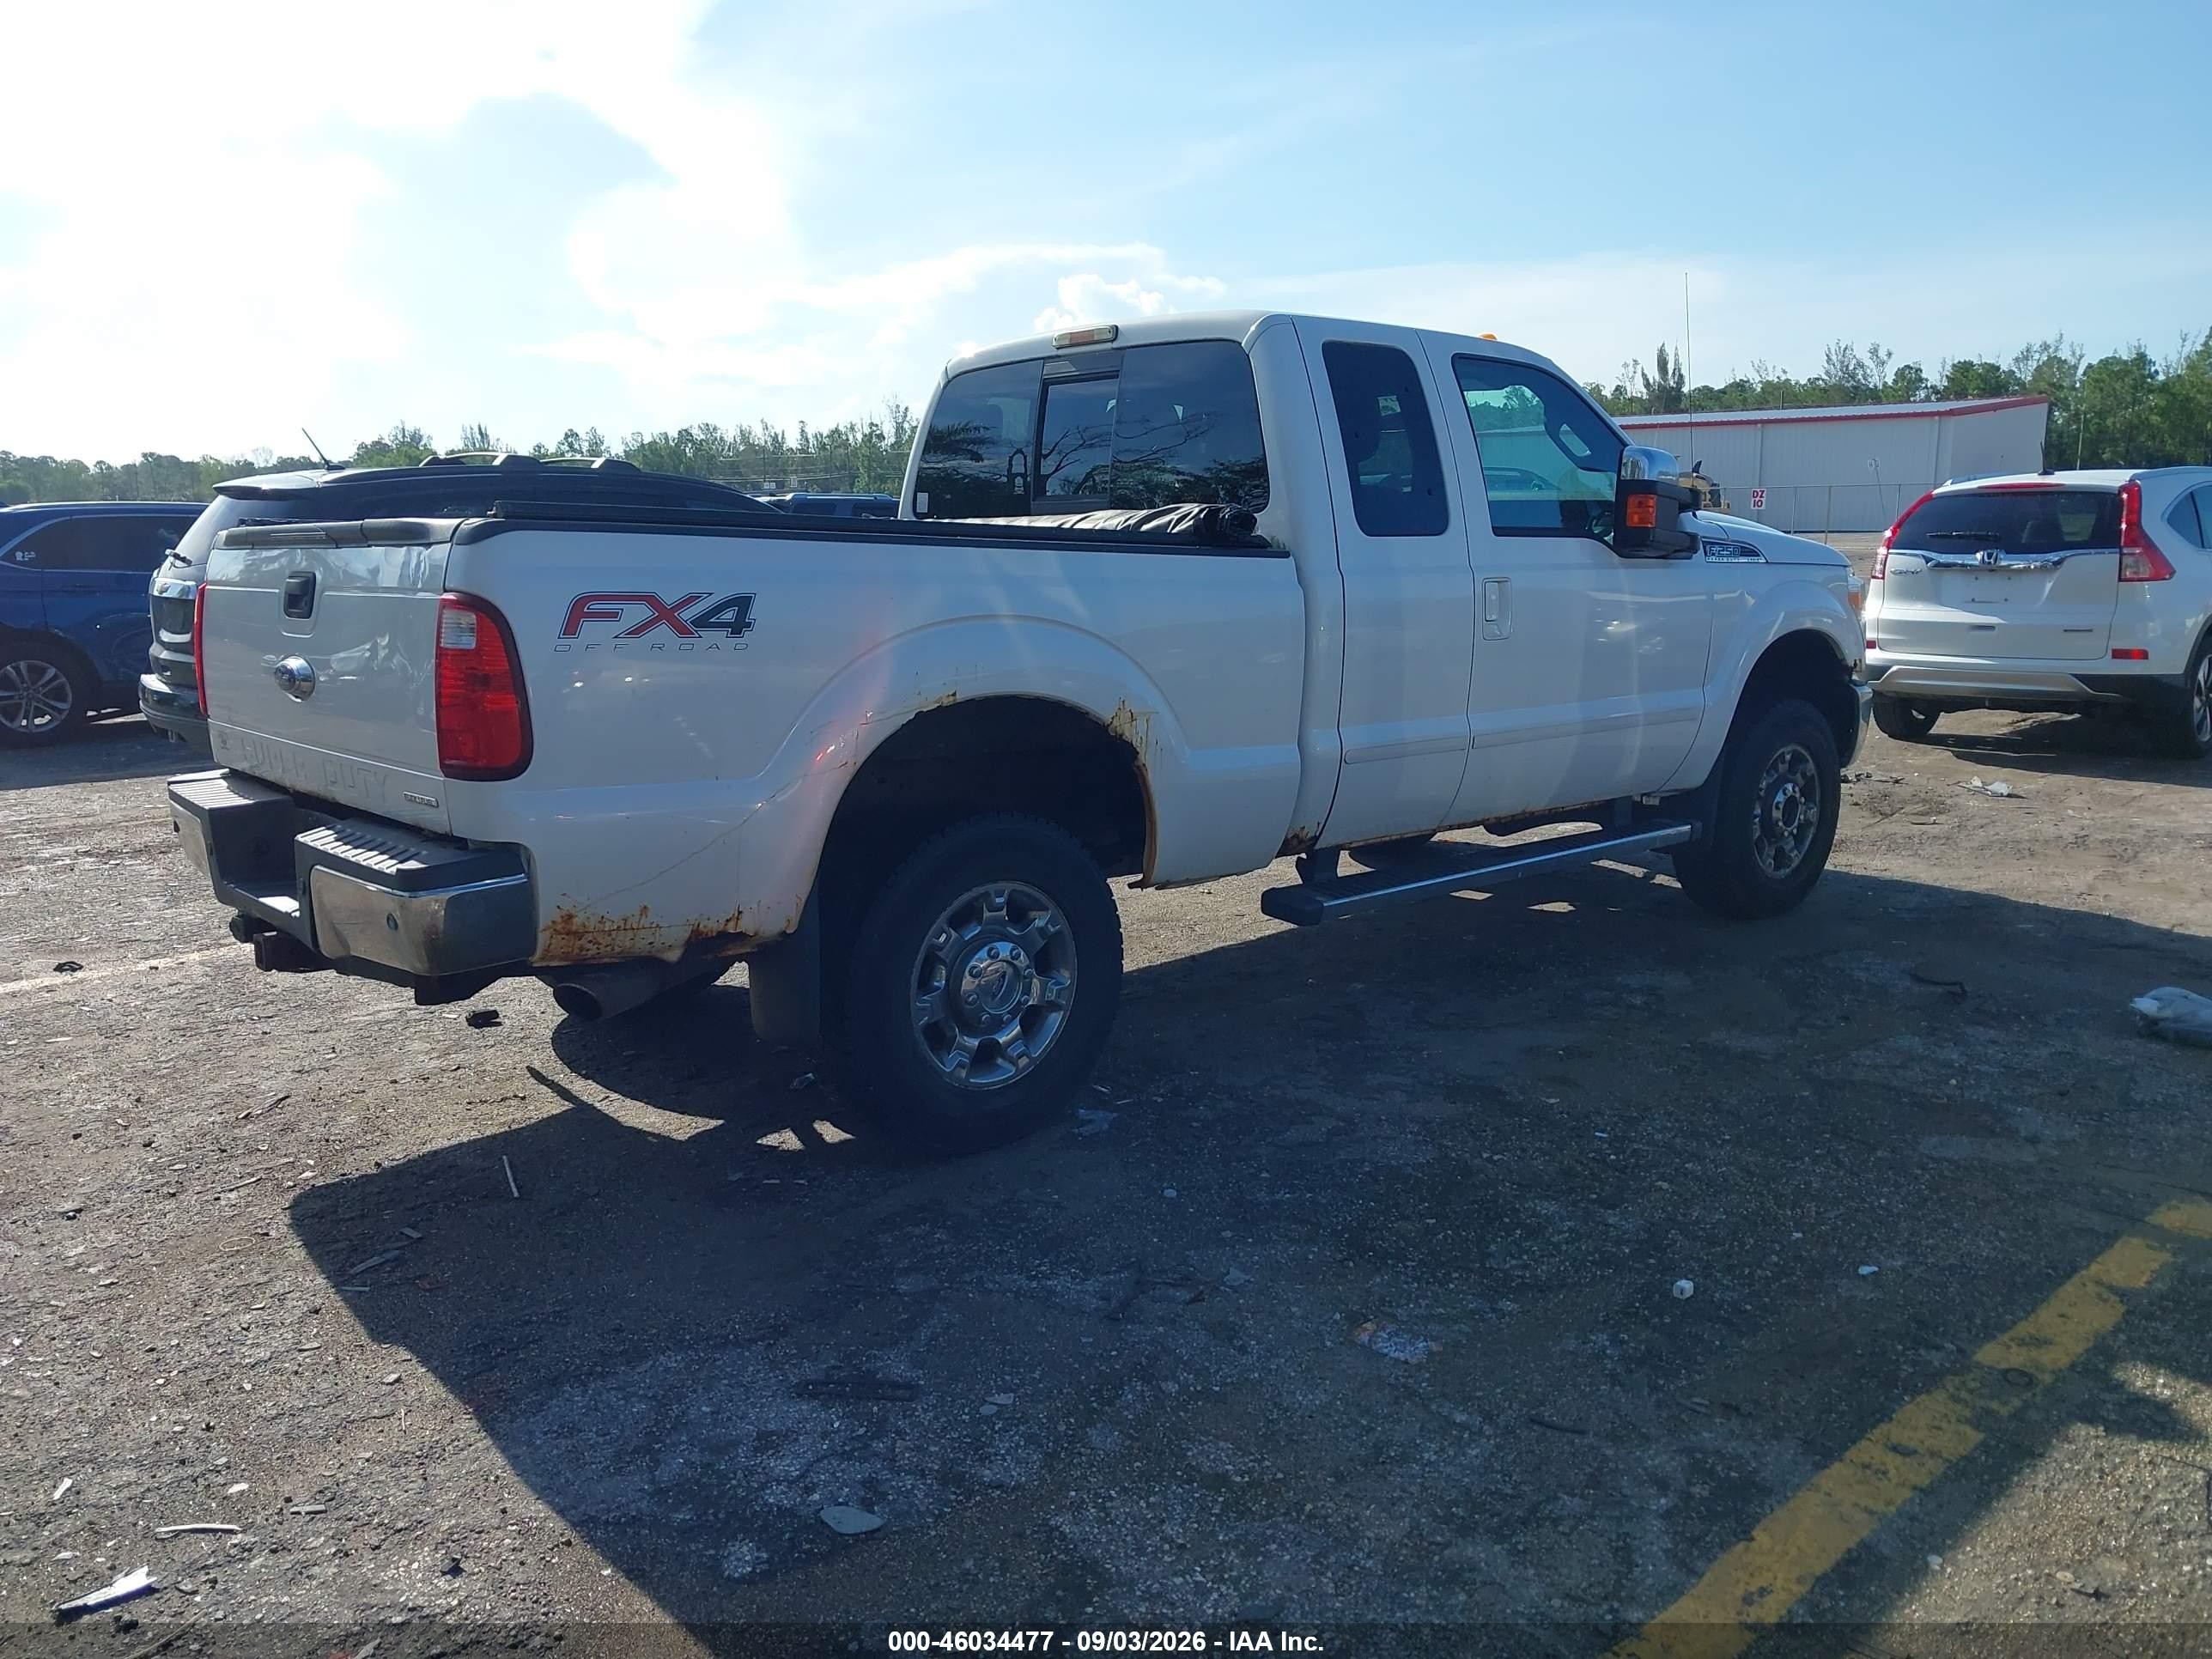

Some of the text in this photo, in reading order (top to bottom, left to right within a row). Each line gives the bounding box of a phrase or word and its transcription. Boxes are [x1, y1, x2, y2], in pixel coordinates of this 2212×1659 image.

[1752, 489, 1765, 499] DZ
[557, 591, 757, 640] FX4
[554, 643, 749, 653] OFF ROAD
[322, 757, 389, 804] DUTY
